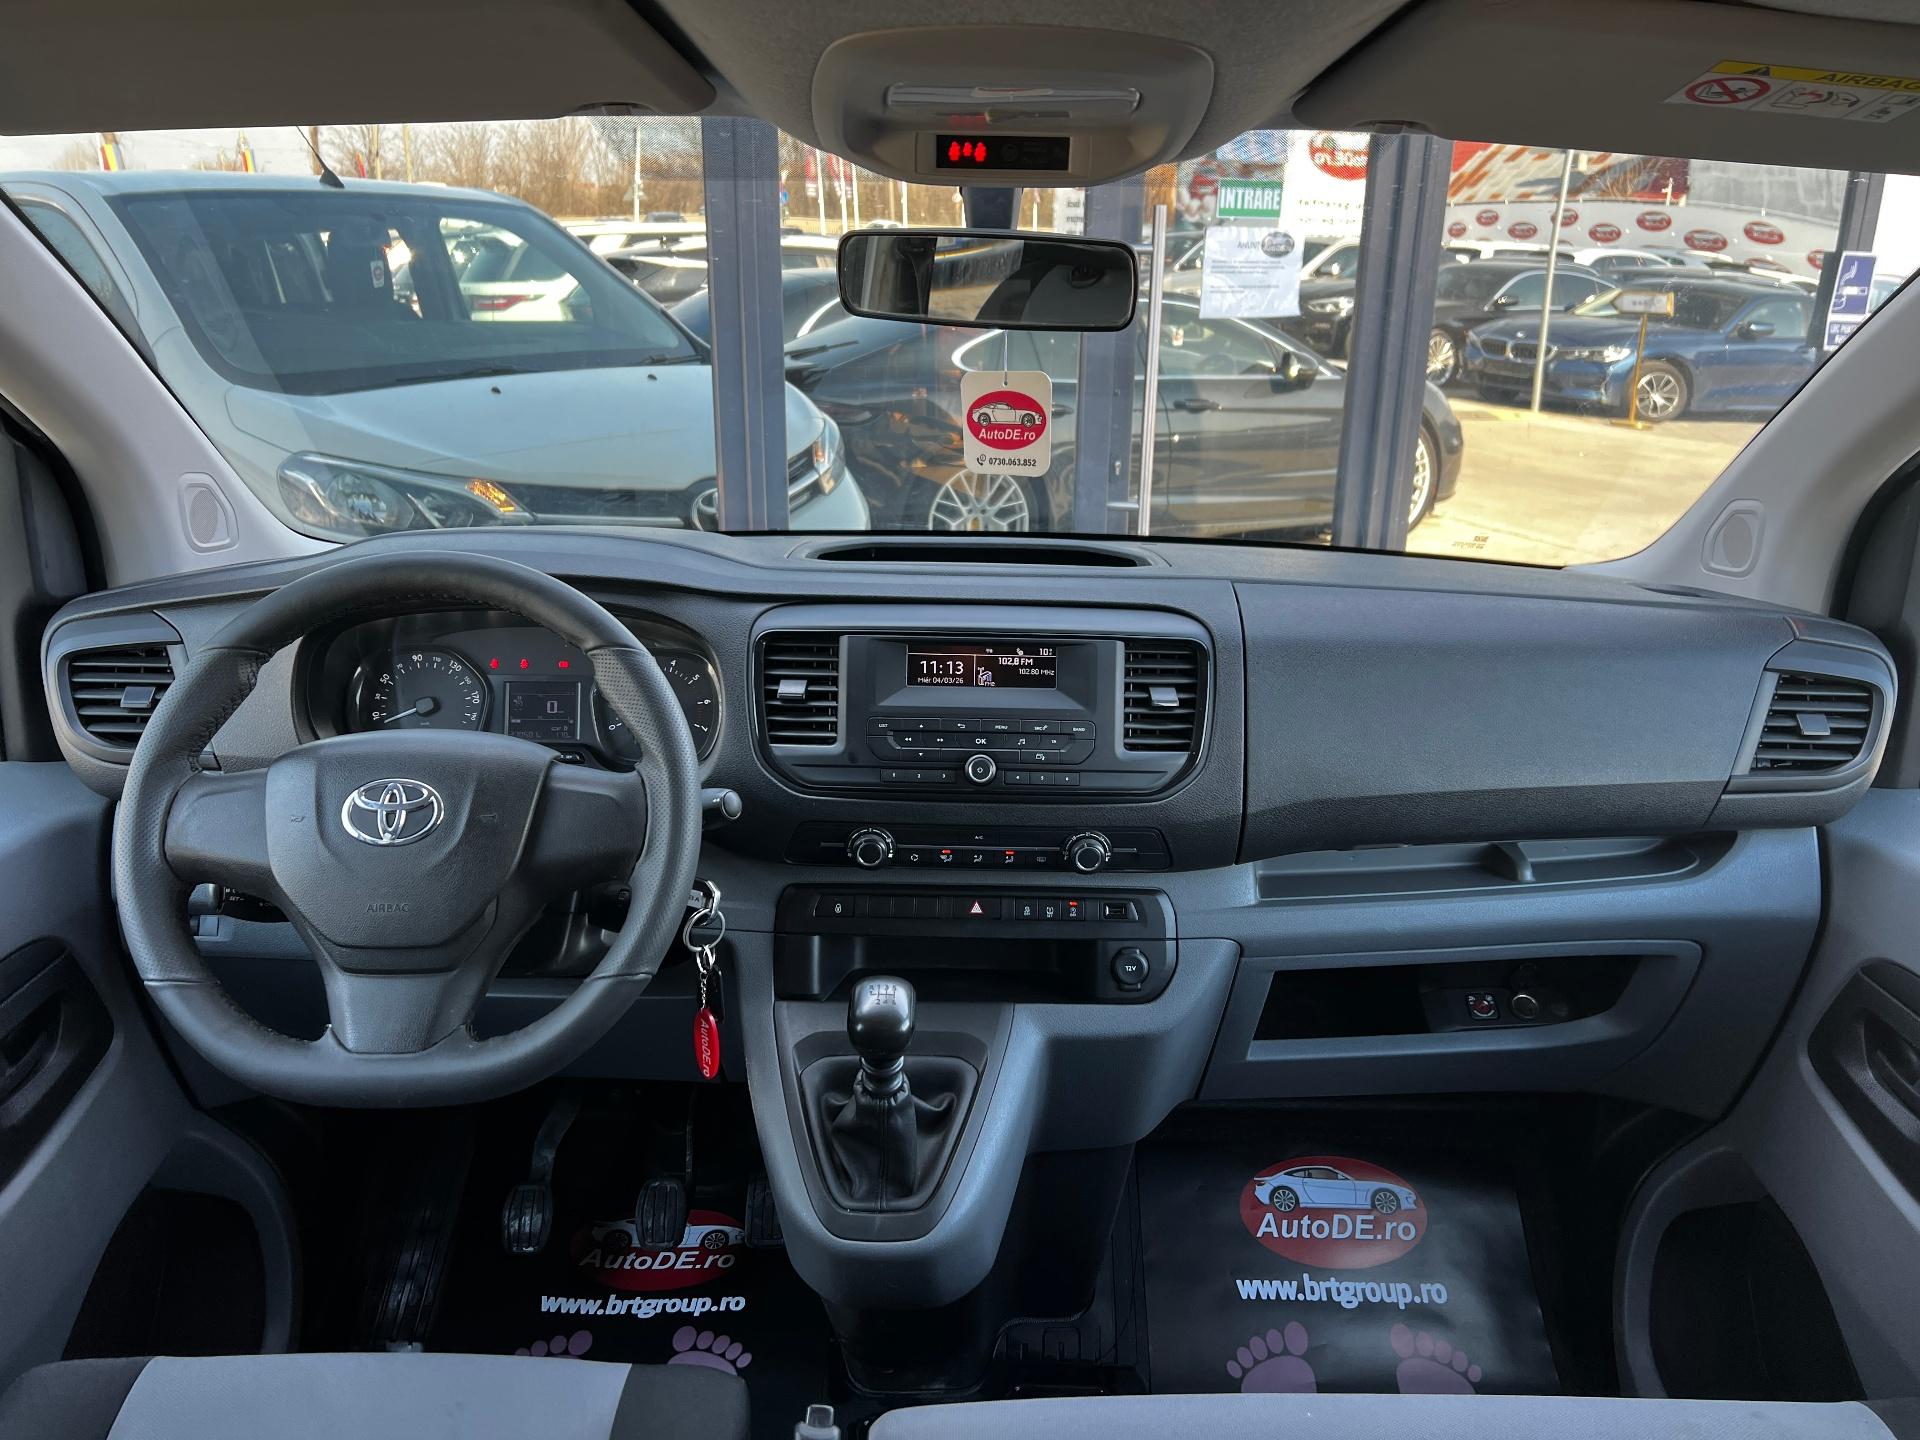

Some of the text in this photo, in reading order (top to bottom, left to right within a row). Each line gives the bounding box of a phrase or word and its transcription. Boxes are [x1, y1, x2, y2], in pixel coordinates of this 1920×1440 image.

[1220, 186, 1281, 210] INTRARE
[978, 428, 1036, 440] AutoDE.ro
[988, 457, 1037, 467] 0730.063.852
[411, 654, 423, 662] 90
[998, 657, 1033, 666] 102,8 FM
[448, 660, 462, 672] 130
[920, 660, 964, 675] 11:13
[380, 674, 390, 684] 50
[932, 676, 964, 684] 04/03/26
[471, 690, 480, 704] 170
[372, 711, 380, 721] 10
[366, 903, 409, 913] AIRBAG
[700, 1019, 712, 1078] AutoDE.ro
[1256, 1212, 1416, 1241] AutoDE.ro
[579, 1249, 736, 1270] AutoDE.ro
[1236, 1272, 1448, 1309] www.brtgroup.ro
[541, 1294, 746, 1318] www.brtgroup.ro
